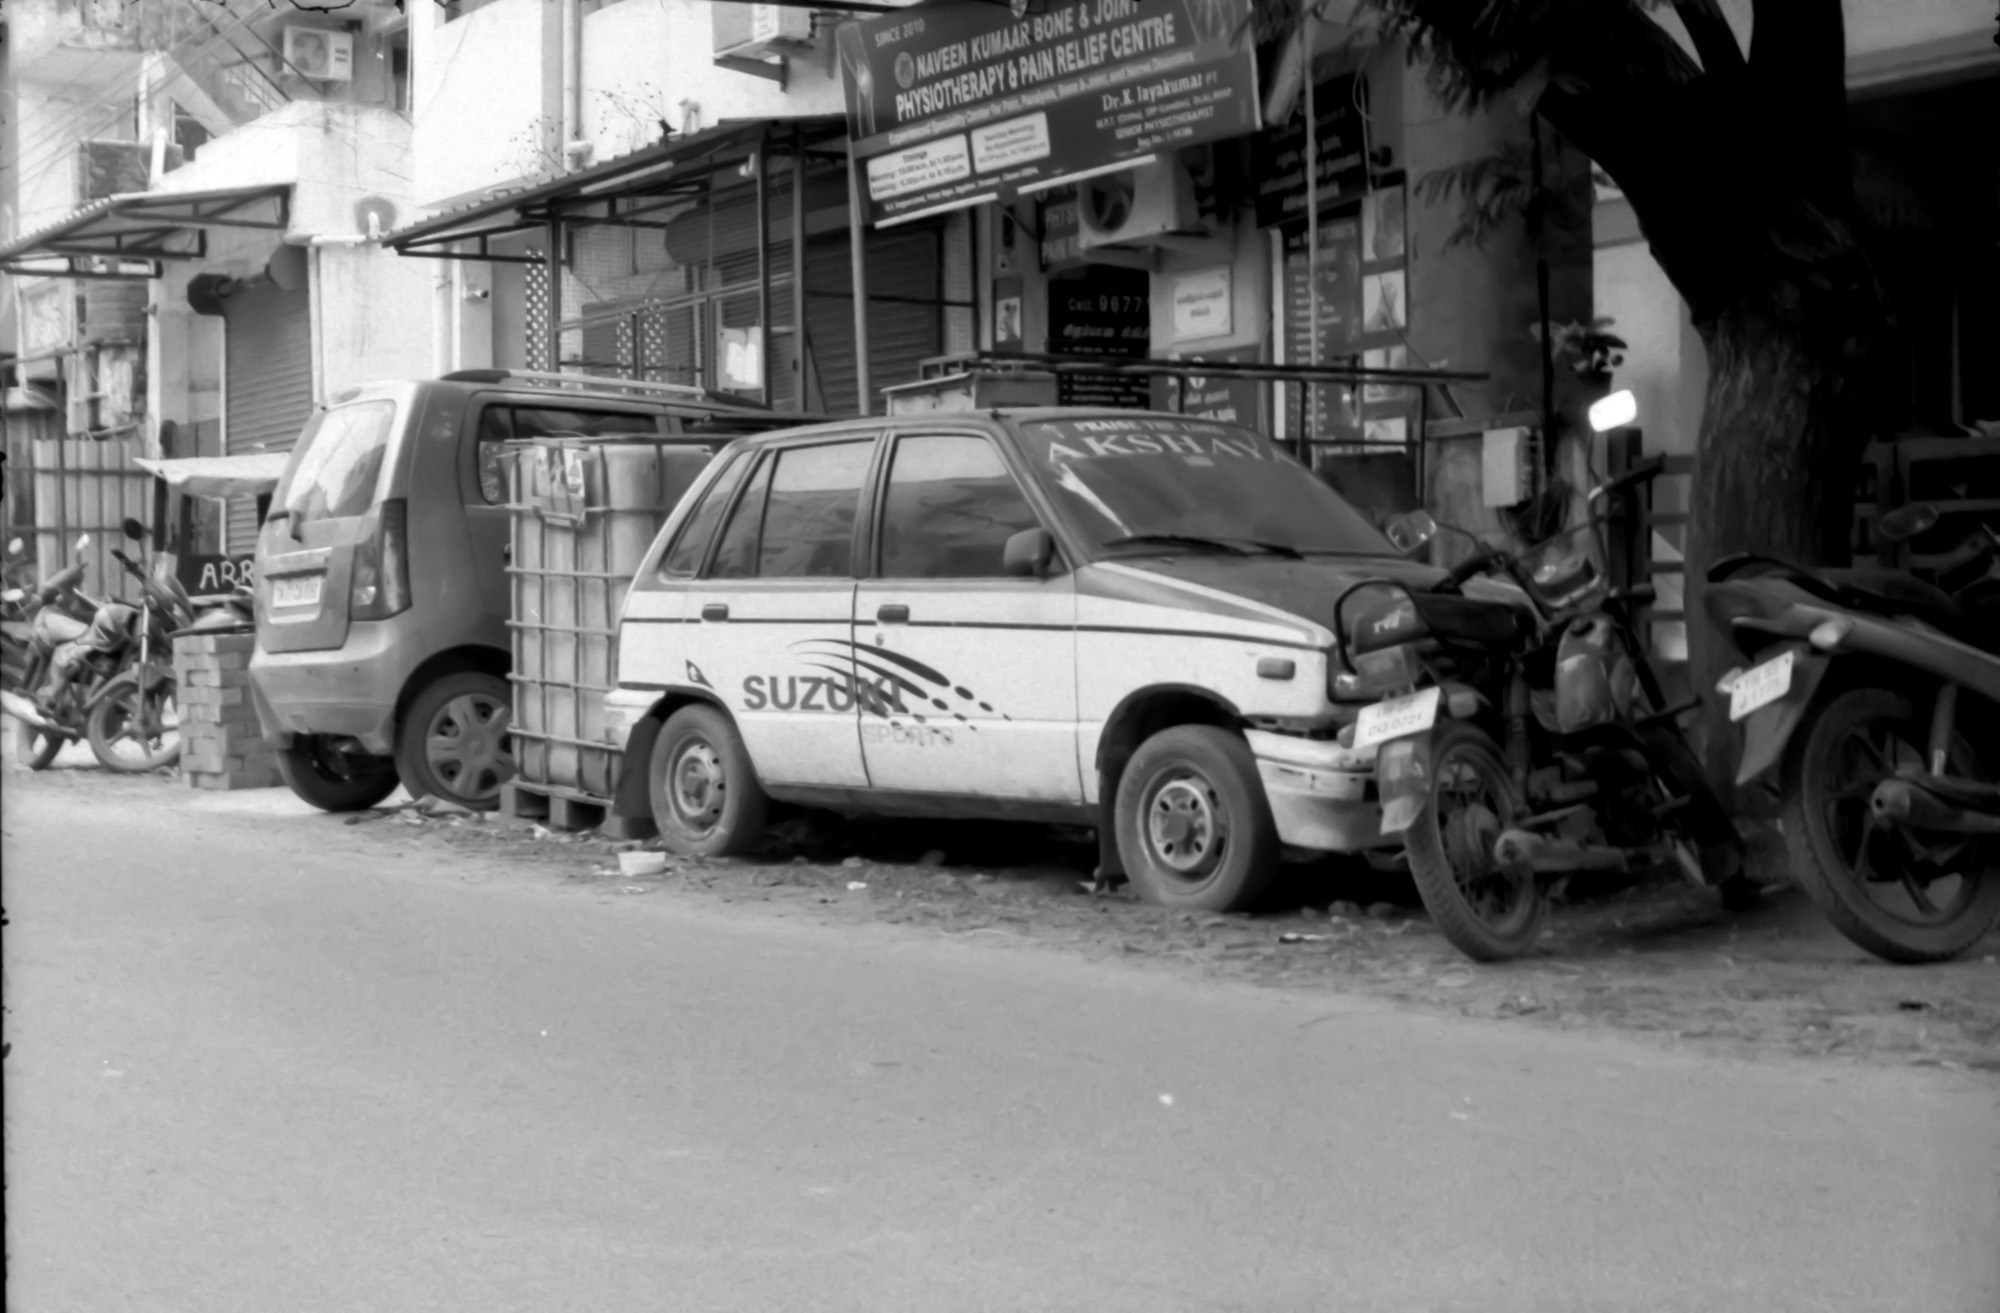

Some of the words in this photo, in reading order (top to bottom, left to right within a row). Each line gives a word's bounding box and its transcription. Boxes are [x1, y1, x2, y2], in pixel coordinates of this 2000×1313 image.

[895, 62, 1005, 122] PHYSIOTHERAPY
[1007, 60, 1018, 89] &
[1020, 49, 1054, 85] PAIN
[1056, 32, 1108, 74] RELIEF
[1110, 12, 1176, 58] CENTRE
[917, 41, 968, 79] NAVEEN
[971, 22, 1031, 64] KUMAAR
[1034, 6, 1074, 42] BONE
[1079, 3, 1089, 29] &
[1093, 0, 1139, 25] JOINT
[742, 674, 901, 716] SUZUKI
